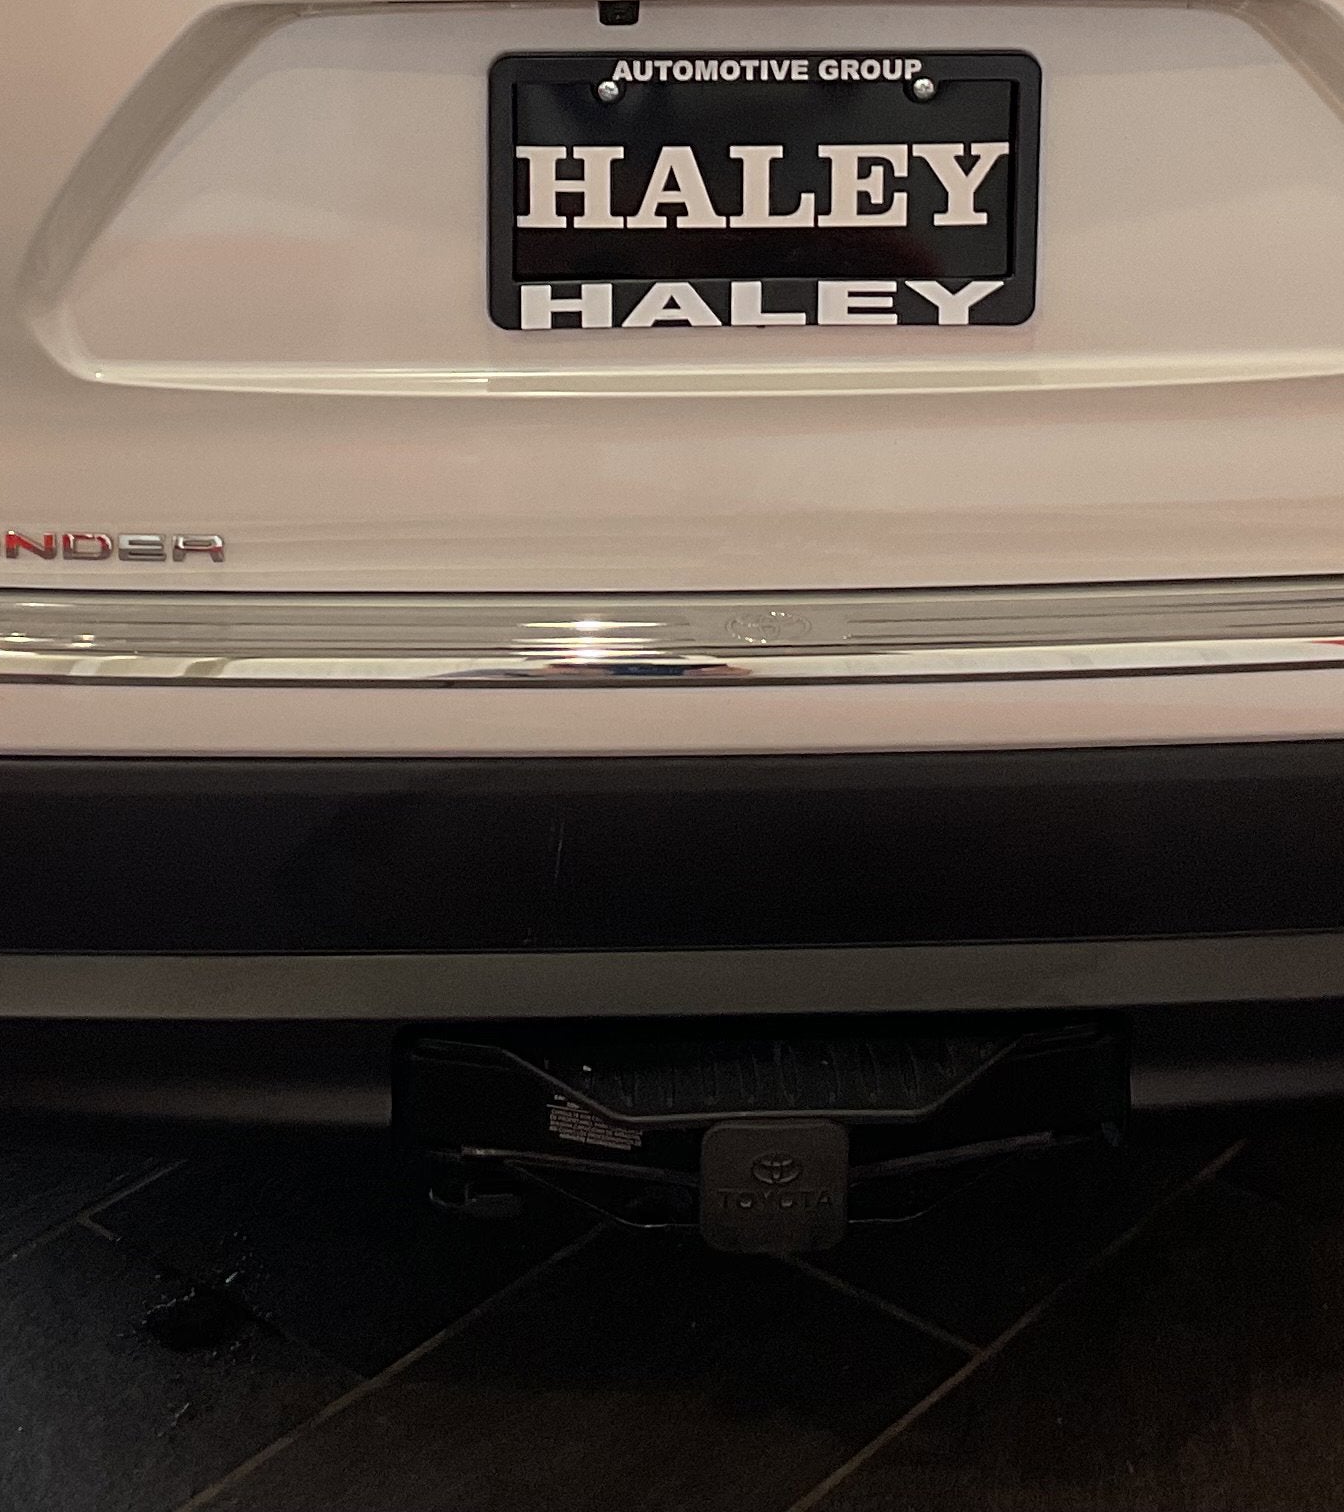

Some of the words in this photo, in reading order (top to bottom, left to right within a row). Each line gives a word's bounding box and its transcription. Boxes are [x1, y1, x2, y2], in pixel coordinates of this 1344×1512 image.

[612, 58, 809, 83] AUTOMOTIVE
[817, 58, 924, 82] GROUP
[515, 140, 1010, 230] HALEY
[519, 279, 1005, 331] HALEY
[718, 1187, 833, 1210] TOYOTA
